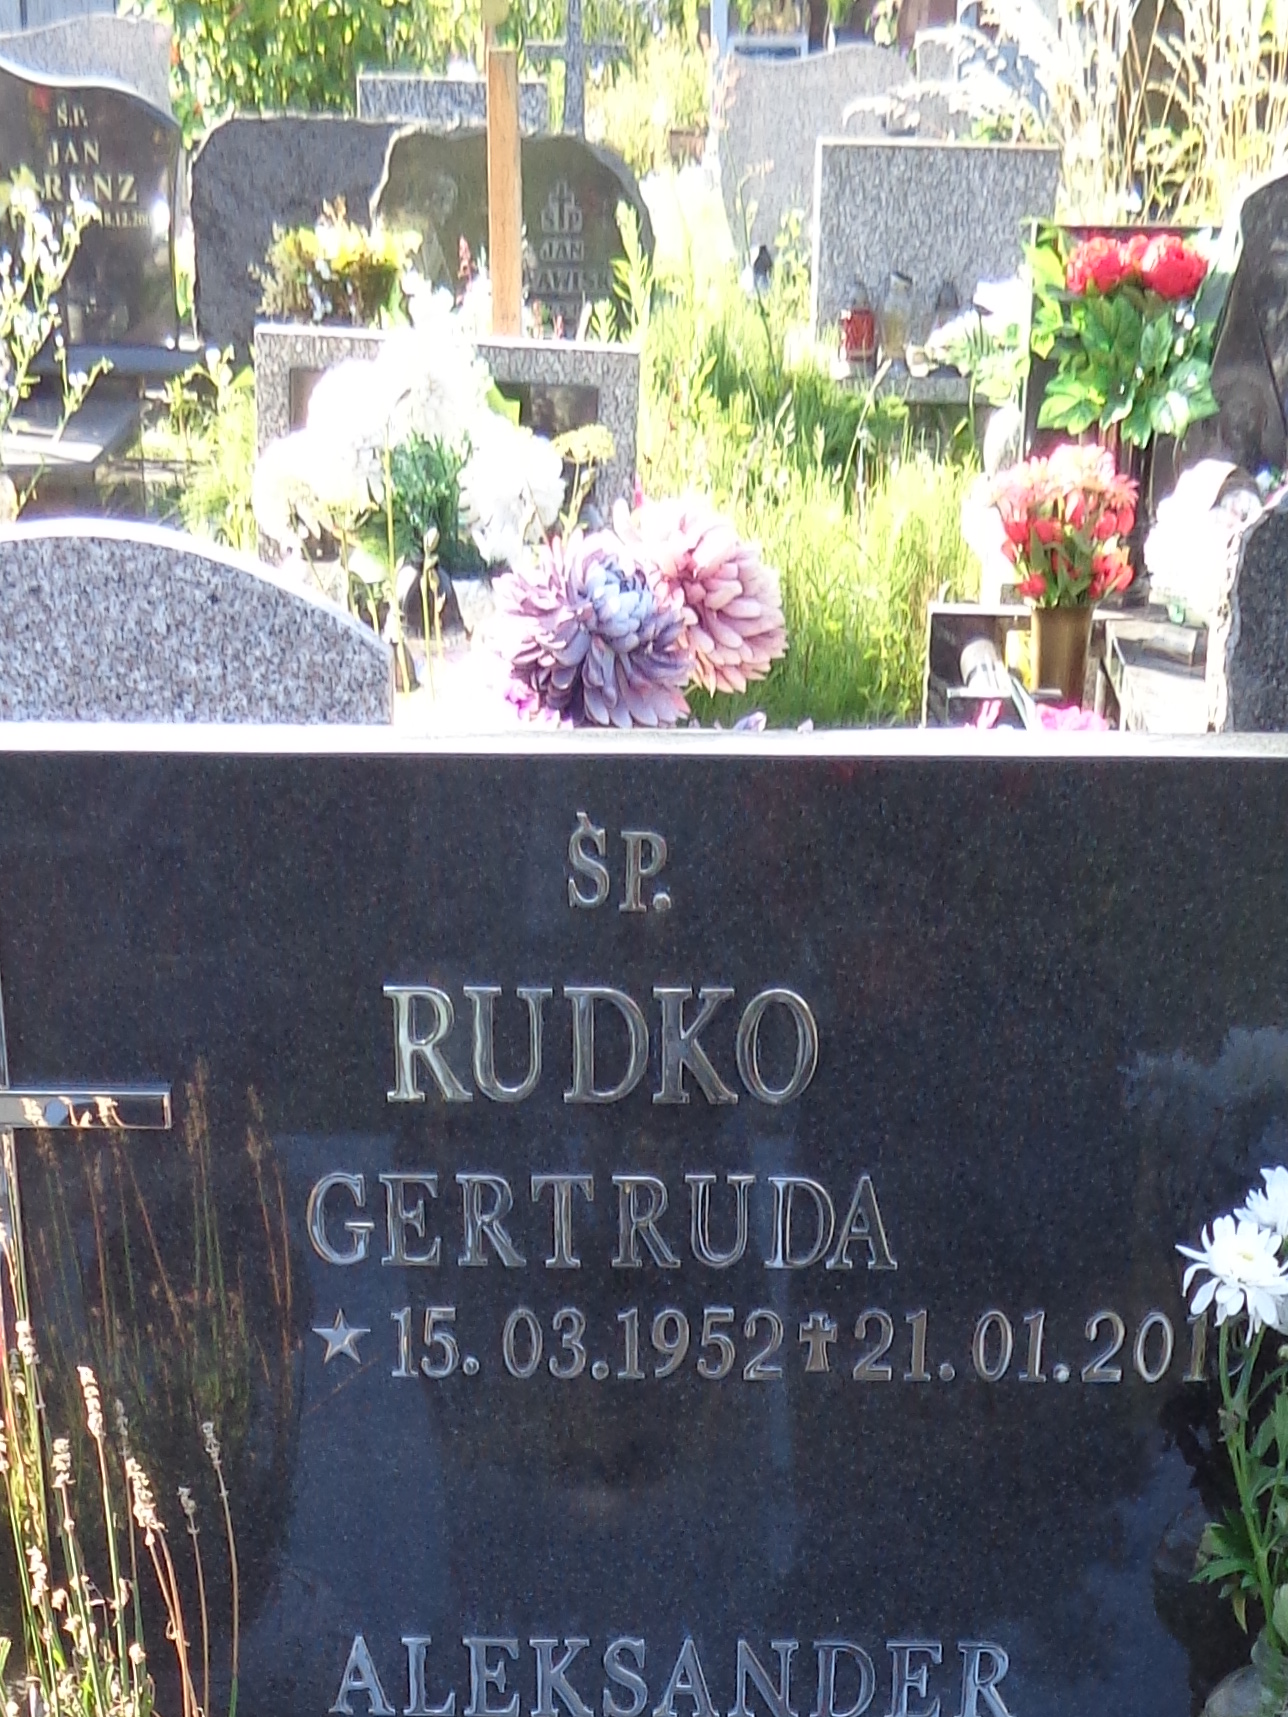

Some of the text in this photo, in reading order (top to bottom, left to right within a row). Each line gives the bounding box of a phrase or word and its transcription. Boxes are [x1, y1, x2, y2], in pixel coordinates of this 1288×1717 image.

[48, 139, 101, 166] JAN
[40, 173, 138, 203] RENZ
[382, 984, 820, 1105] RUDKO
[307, 1172, 899, 1272] GERTRUDA
